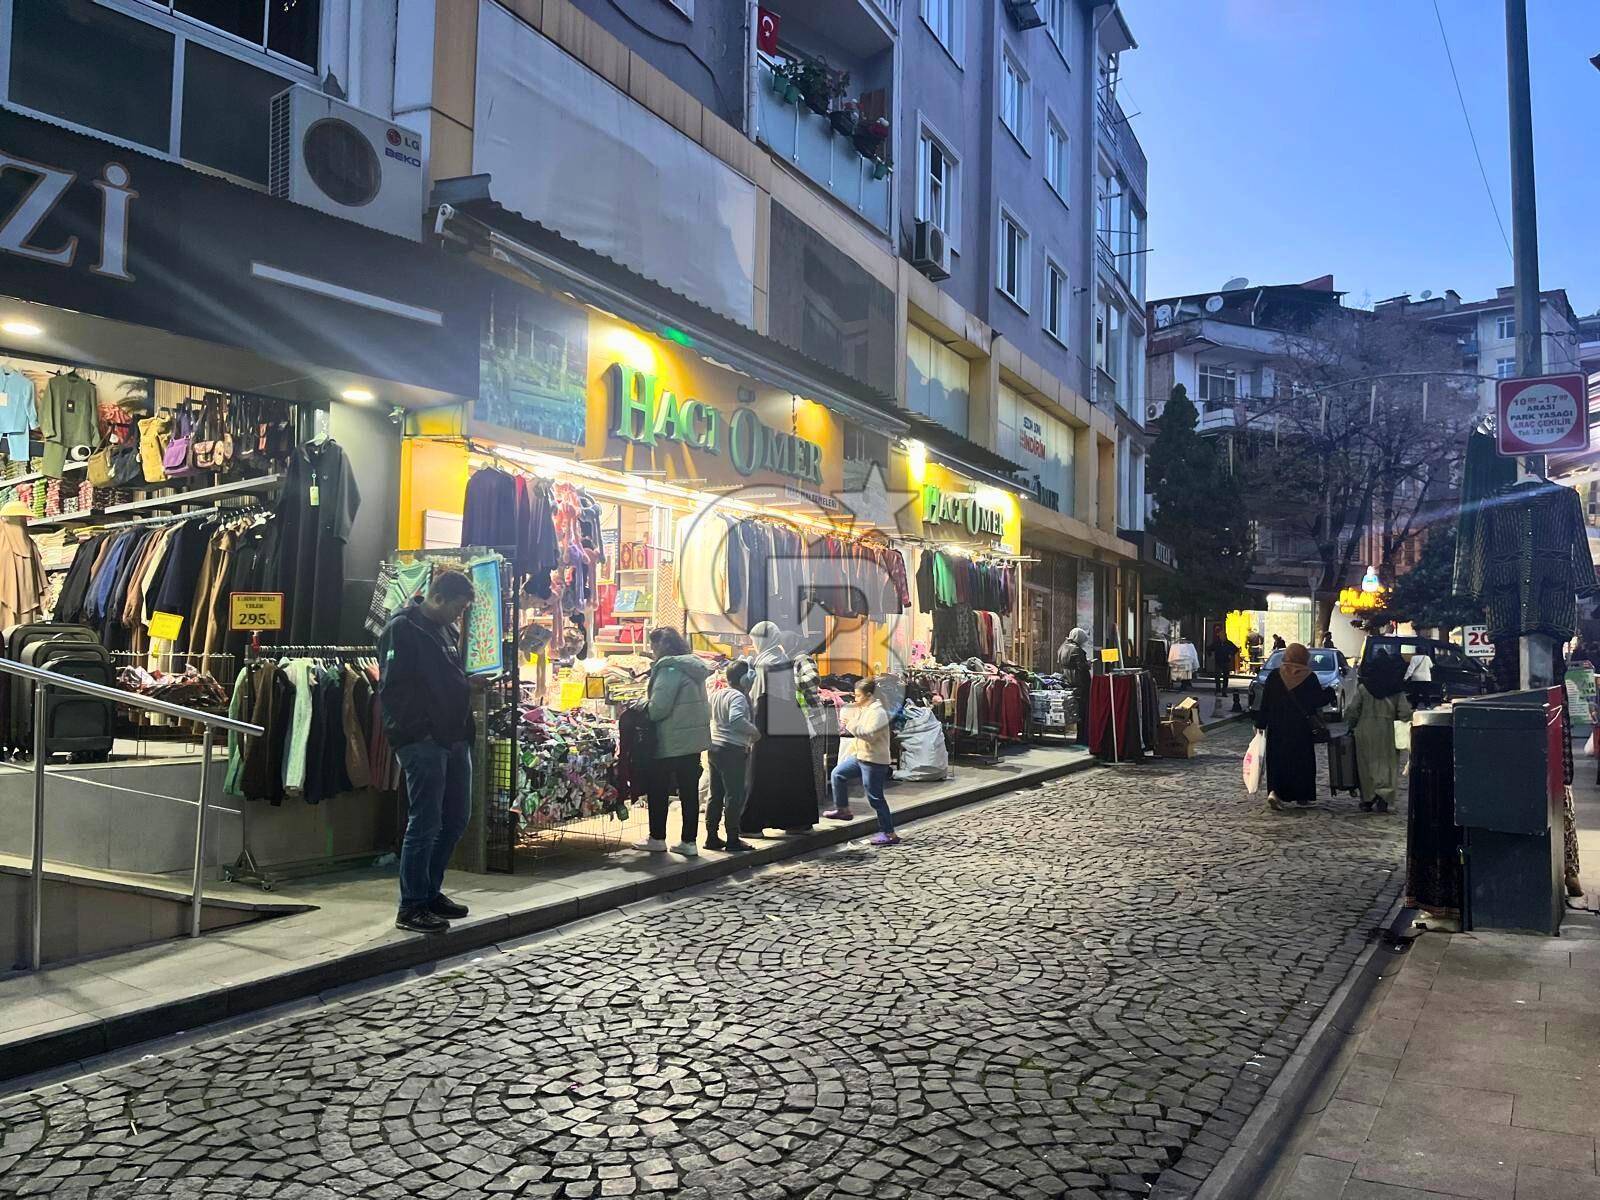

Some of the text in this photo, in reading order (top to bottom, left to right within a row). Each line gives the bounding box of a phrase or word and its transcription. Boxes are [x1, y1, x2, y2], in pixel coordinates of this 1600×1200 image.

[405, 136, 420, 151] LG
[385, 147, 421, 167] BEKO
[1510, 410, 1573, 421] PARK YASAĞI
[1527, 404, 1556, 412] ARASI
[608, 362, 823, 485] HACI ÖMER
[922, 484, 963, 526] HACI
[239, 613, 266, 625] 295
